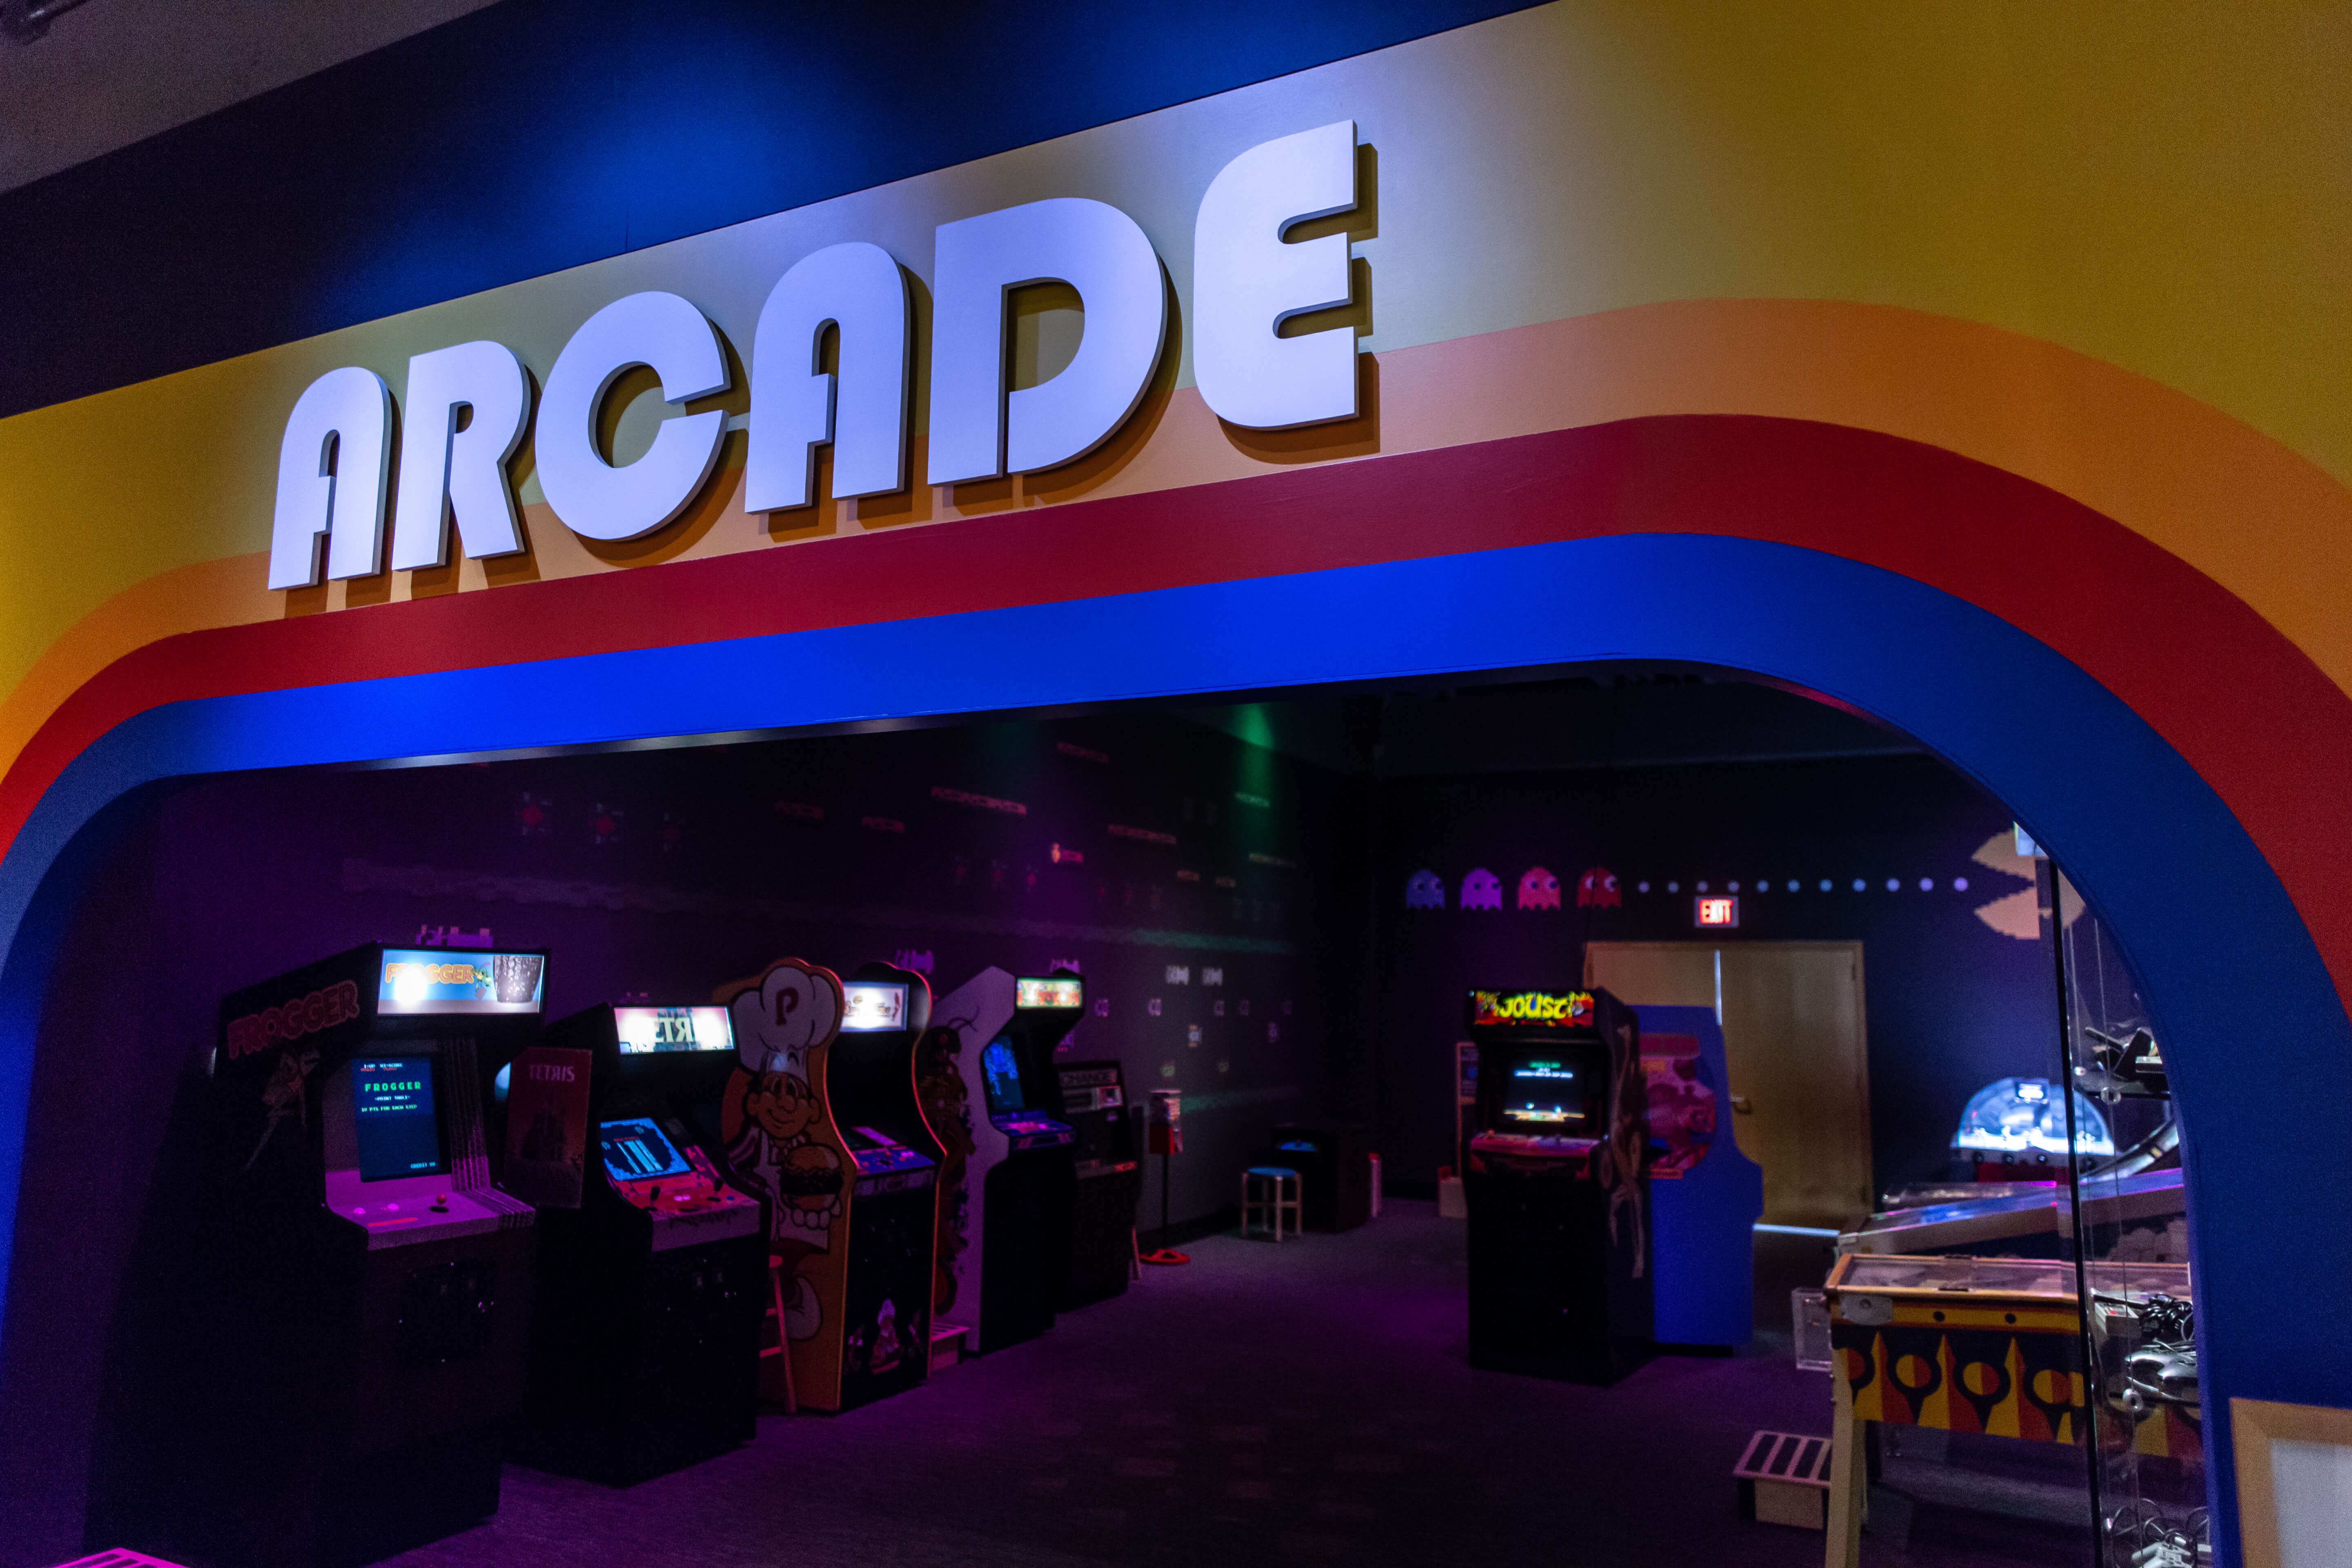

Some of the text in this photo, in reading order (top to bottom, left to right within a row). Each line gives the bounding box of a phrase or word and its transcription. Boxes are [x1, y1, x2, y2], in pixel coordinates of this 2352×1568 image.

[268, 120, 1359, 590] ARCADE
[1699, 899, 1733, 924] EXIT
[385, 963, 474, 983] FGGER
[1499, 992, 1568, 1019] JOUST
[227, 979, 360, 1060] FROGGER
[365, 1081, 421, 1092] FROGGER
